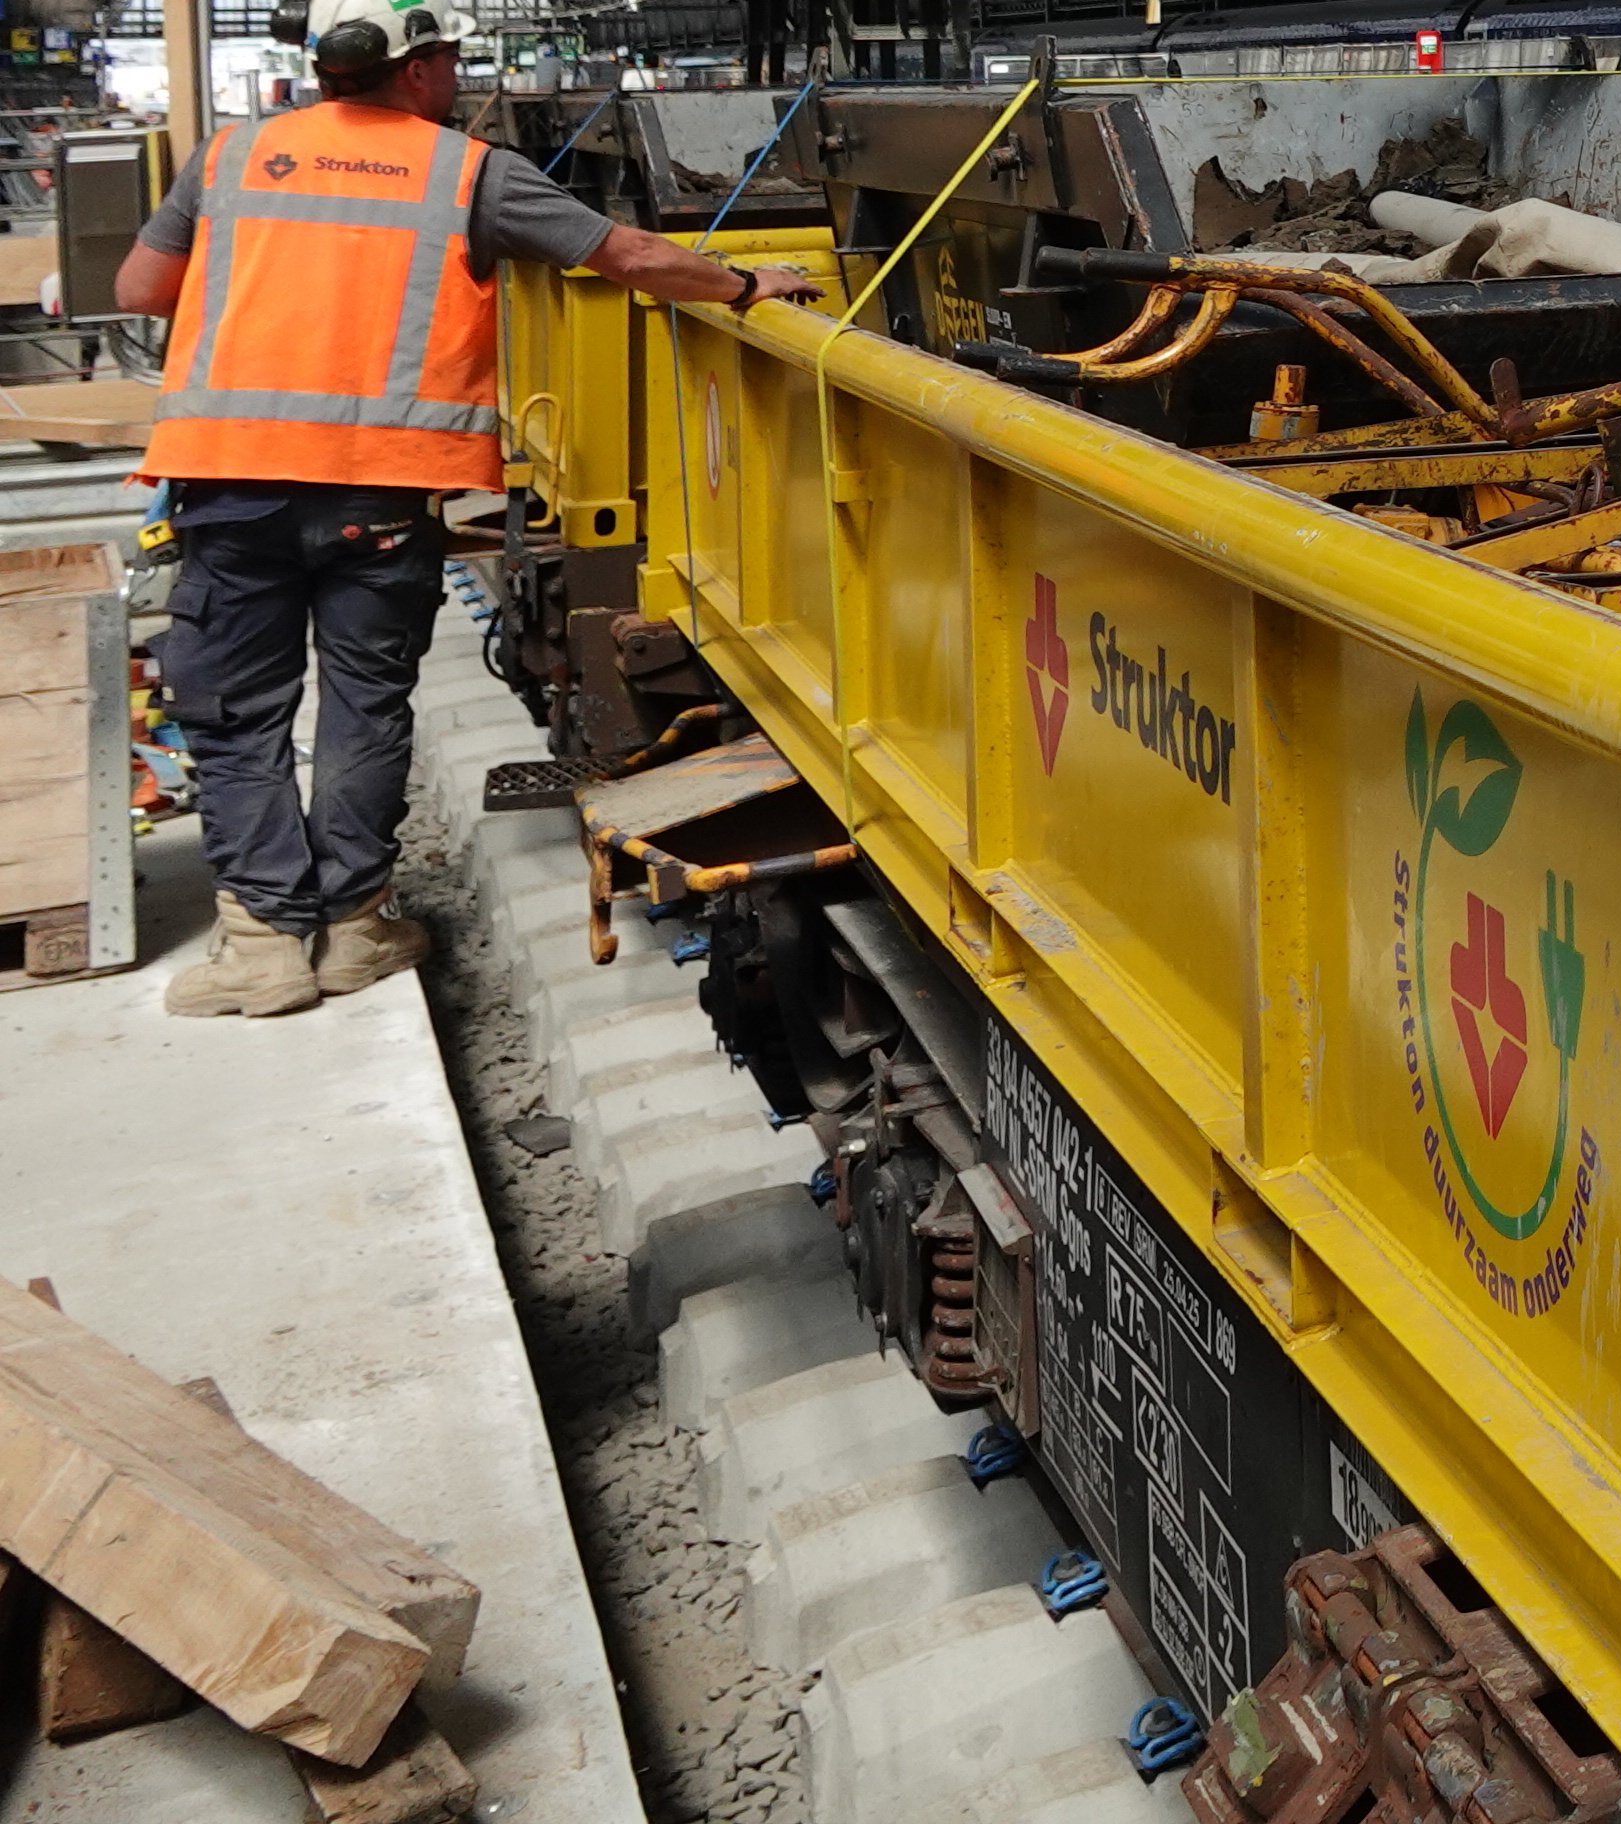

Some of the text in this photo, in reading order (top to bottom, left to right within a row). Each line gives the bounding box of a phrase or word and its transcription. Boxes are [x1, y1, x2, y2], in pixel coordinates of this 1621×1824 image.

[313, 155, 410, 178] Strukton
[1394, 849, 1598, 1319] Strukton duurzaam onderweg
[1003, 1039, 1018, 1110] 84
[1019, 1064, 1052, 1153] 4557
[1052, 1105, 1094, 1212] 042-1
[986, 1075, 1092, 1277] RIV NL-SRM Sgns
[1111, 1192, 1131, 1242] REV
[1109, 1263, 1125, 1328] R
[1091, 1319, 1117, 1386] 1170
[1215, 1308, 1236, 1376] 869
